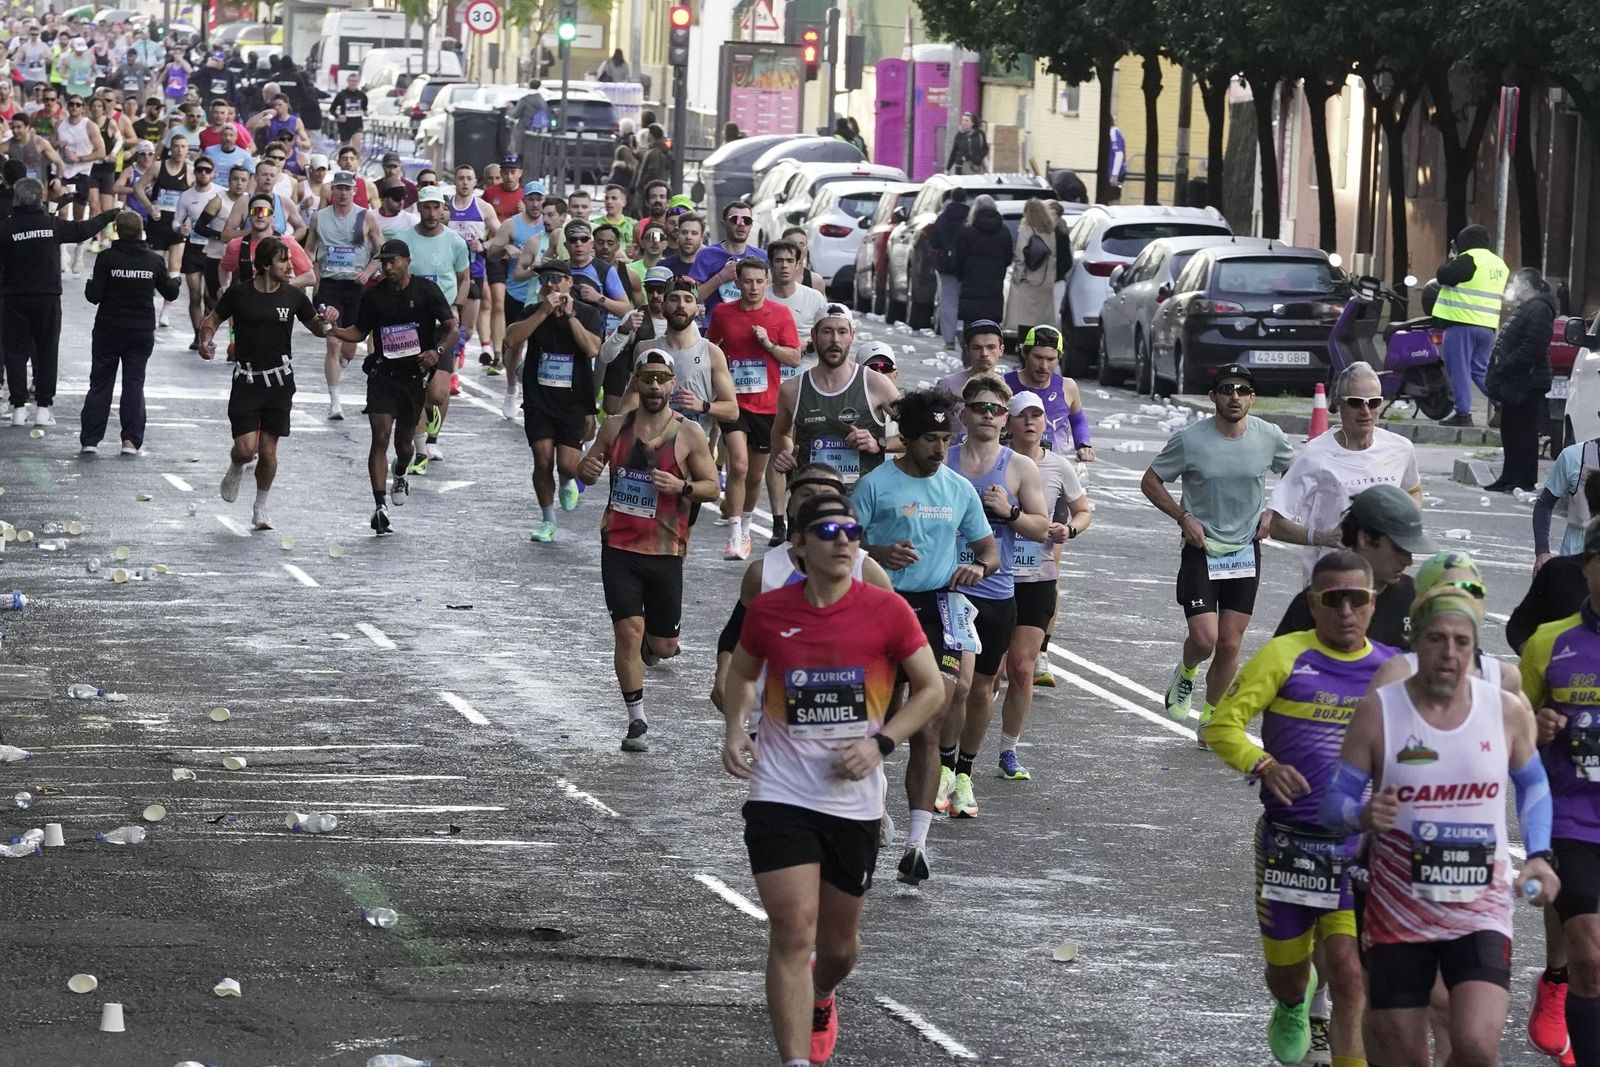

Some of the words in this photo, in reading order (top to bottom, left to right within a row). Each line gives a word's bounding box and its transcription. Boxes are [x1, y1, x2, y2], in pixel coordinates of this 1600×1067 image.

[472, 10, 493, 23] 30
[12, 229, 54, 241] VOLUNTEER
[111, 269, 154, 279] VOLUNTEER
[276, 307, 290, 318] W
[383, 338, 420, 351] FERNANDO
[1257, 352, 1284, 362] 4249
[735, 377, 762, 385] GEORGE
[612, 489, 639, 505] PEDRO
[641, 496, 656, 508] GIL
[918, 511, 953, 521] running
[1208, 562, 1230, 571] CHEMA
[1231, 560, 1256, 569] ARENAS
[812, 671, 856, 683] ZURICH
[814, 692, 839, 704] 4742
[796, 705, 859, 723] SAMUEL
[1397, 783, 1499, 803] CAMINO
[1443, 826, 1488, 839] ZURICH
[1264, 868, 1327, 892] EDUARDO
[1420, 864, 1488, 884] PAQUITO
